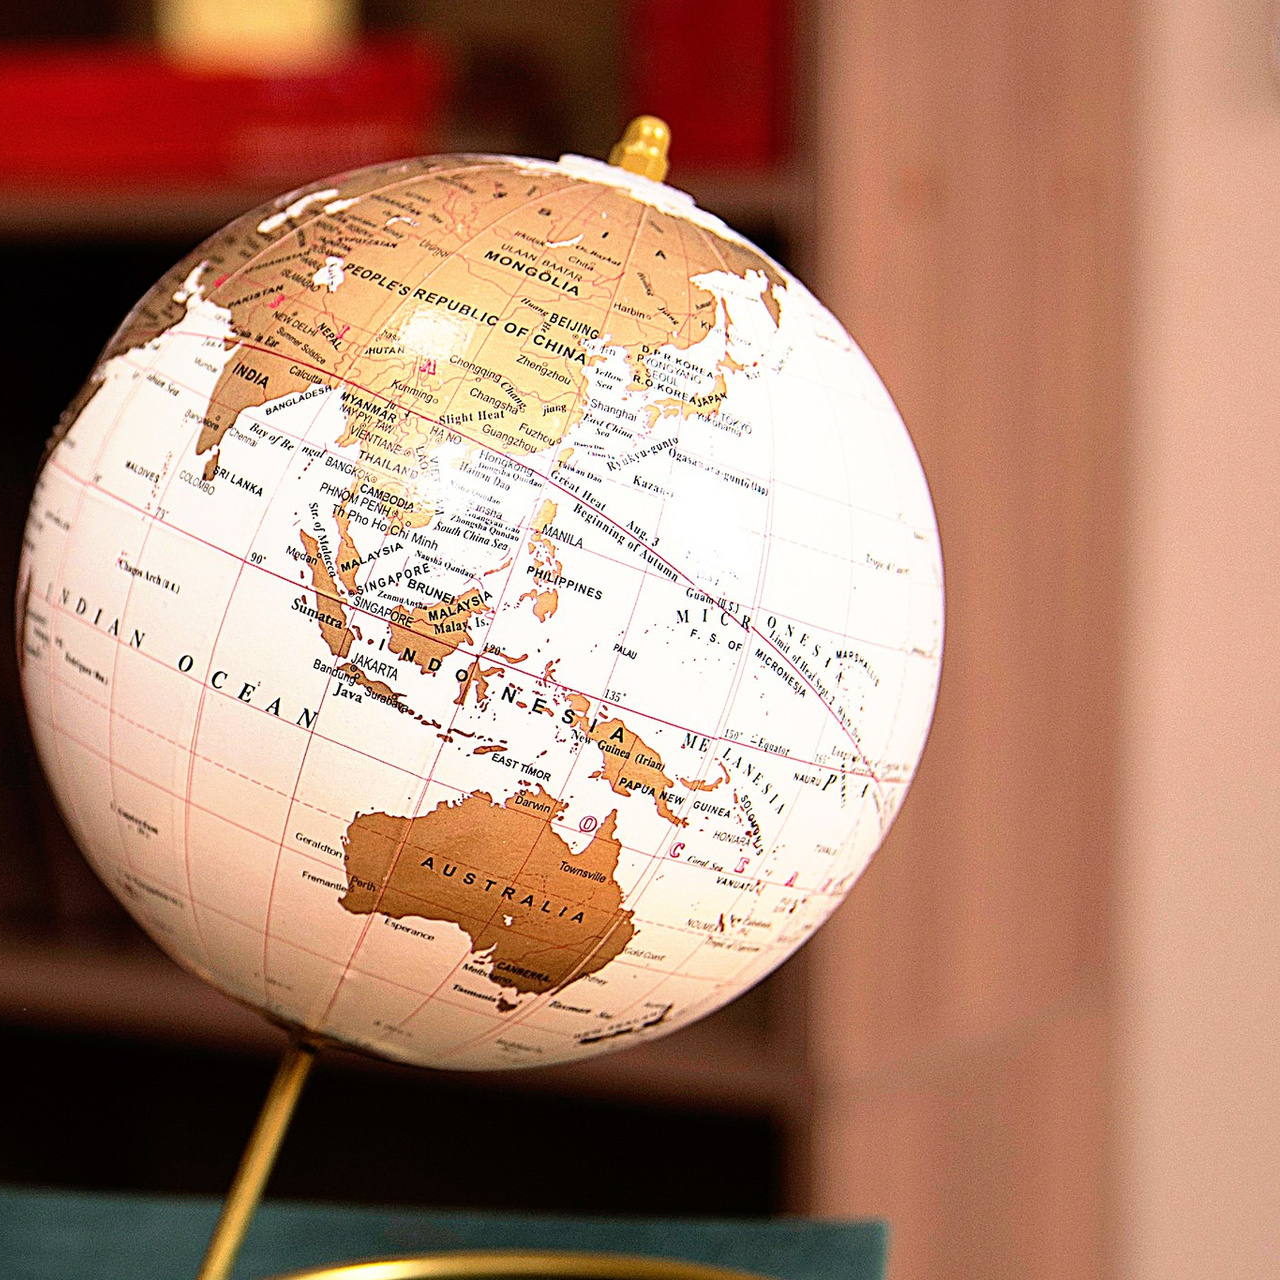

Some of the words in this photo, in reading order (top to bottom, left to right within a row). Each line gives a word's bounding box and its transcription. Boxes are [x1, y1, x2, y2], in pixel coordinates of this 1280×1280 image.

[484, 251, 579, 296] MONGOLIA
[501, 243, 538, 261] ULAAN
[542, 260, 582, 282] BAATAR
[344, 263, 411, 296] PEOPLE'S
[412, 288, 499, 327] REPUBLIC
[504, 323, 529, 337] OF
[533, 334, 586, 365] CHINA
[521, 298, 549, 317] Huang
[613, 302, 645, 319] Harbin
[272, 310, 291, 324] NEW
[291, 319, 318, 336] DELHI
[318, 322, 341, 350] NEPAL
[550, 313, 600, 339] BEIJING
[232, 362, 269, 388] INDIA
[289, 365, 323, 384] Calcutta
[450, 355, 502, 383] Chongqing
[516, 354, 571, 386] Zhengzhou
[265, 385, 332, 416] BANGLADESH
[392, 379, 433, 404] Kunming
[470, 388, 519, 415] Changsha
[697, 392, 727, 407] JAPAN
[341, 392, 397, 423] MYANMAR
[439, 413, 472, 425] Slight
[477, 411, 504, 421] Heat
[590, 399, 637, 422] Shanghai
[249, 423, 264, 437] Bay
[350, 426, 402, 454] VIENTIANE
[482, 424, 537, 453] Guangzhou
[519, 423, 556, 446] Fuzhou
[605, 421, 633, 440] China
[325, 457, 371, 482] BANGKOK
[359, 451, 419, 479] THAILAND
[179, 470, 215, 496] COLOMBO
[214, 466, 229, 479] SRI
[230, 473, 264, 497] LANKA
[320, 482, 358, 506] PHNOM
[360, 498, 391, 516] PENH
[360, 484, 414, 510] CAMBODIA
[550, 469, 580, 494] Great
[582, 489, 607, 512] Heat
[626, 520, 648, 543] Aug.
[347, 510, 369, 526] Pho
[371, 519, 387, 532] Ho
[390, 526, 410, 539] Chi
[411, 533, 438, 551] Minh
[433, 522, 460, 538] South
[463, 529, 489, 546] China
[491, 538, 509, 551] Sea
[542, 524, 584, 549] MANILA
[573, 503, 626, 545] Beginning
[640, 547, 679, 582] Autumn
[286, 545, 318, 565] Medan
[318, 532, 336, 577] Malacca
[341, 542, 404, 572] MALAYSIA
[356, 563, 430, 595] SINGAPORE
[408, 579, 455, 605] BRUNEI
[526, 565, 603, 600] PHILIPPINES
[428, 590, 493, 621] MALAYSIA
[686, 587, 714, 605] Guam
[291, 598, 343, 629] Sumatra
[353, 596, 414, 628] SINGAPORE
[434, 617, 469, 635] Malay
[45, 581, 145, 650] INDIAN
[178, 654, 318, 728] OCEAN
[613, 644, 637, 660] PALAU
[769, 630, 791, 654] Limit
[313, 659, 355, 686] Bandung
[351, 653, 398, 680] JAKARTA
[728, 640, 743, 652] OF
[755, 648, 806, 698] MICRONESIA
[333, 682, 362, 704] Java
[364, 686, 408, 714] Surabaya
[378, 638, 624, 743] INDONESIA
[571, 729, 594, 745] New
[597, 740, 631, 759] Guinea
[635, 753, 666, 772] (Irian)
[758, 738, 790, 756] Equator
[491, 754, 519, 769] EAST
[521, 764, 551, 781] TIMOR
[793, 772, 821, 787] NAURU
[515, 796, 550, 813] Darwin
[619, 777, 655, 797] PAPUA
[659, 790, 684, 806] NEW
[693, 801, 730, 818] GUINEA
[295, 832, 342, 859] Geraldton
[713, 830, 750, 847] HONIARA
[302, 870, 348, 892] Fremantle
[350, 876, 376, 892] Perth
[559, 860, 606, 883] Townsville
[420, 857, 585, 924] AUSTRALIA
[384, 919, 434, 941] Esperance
